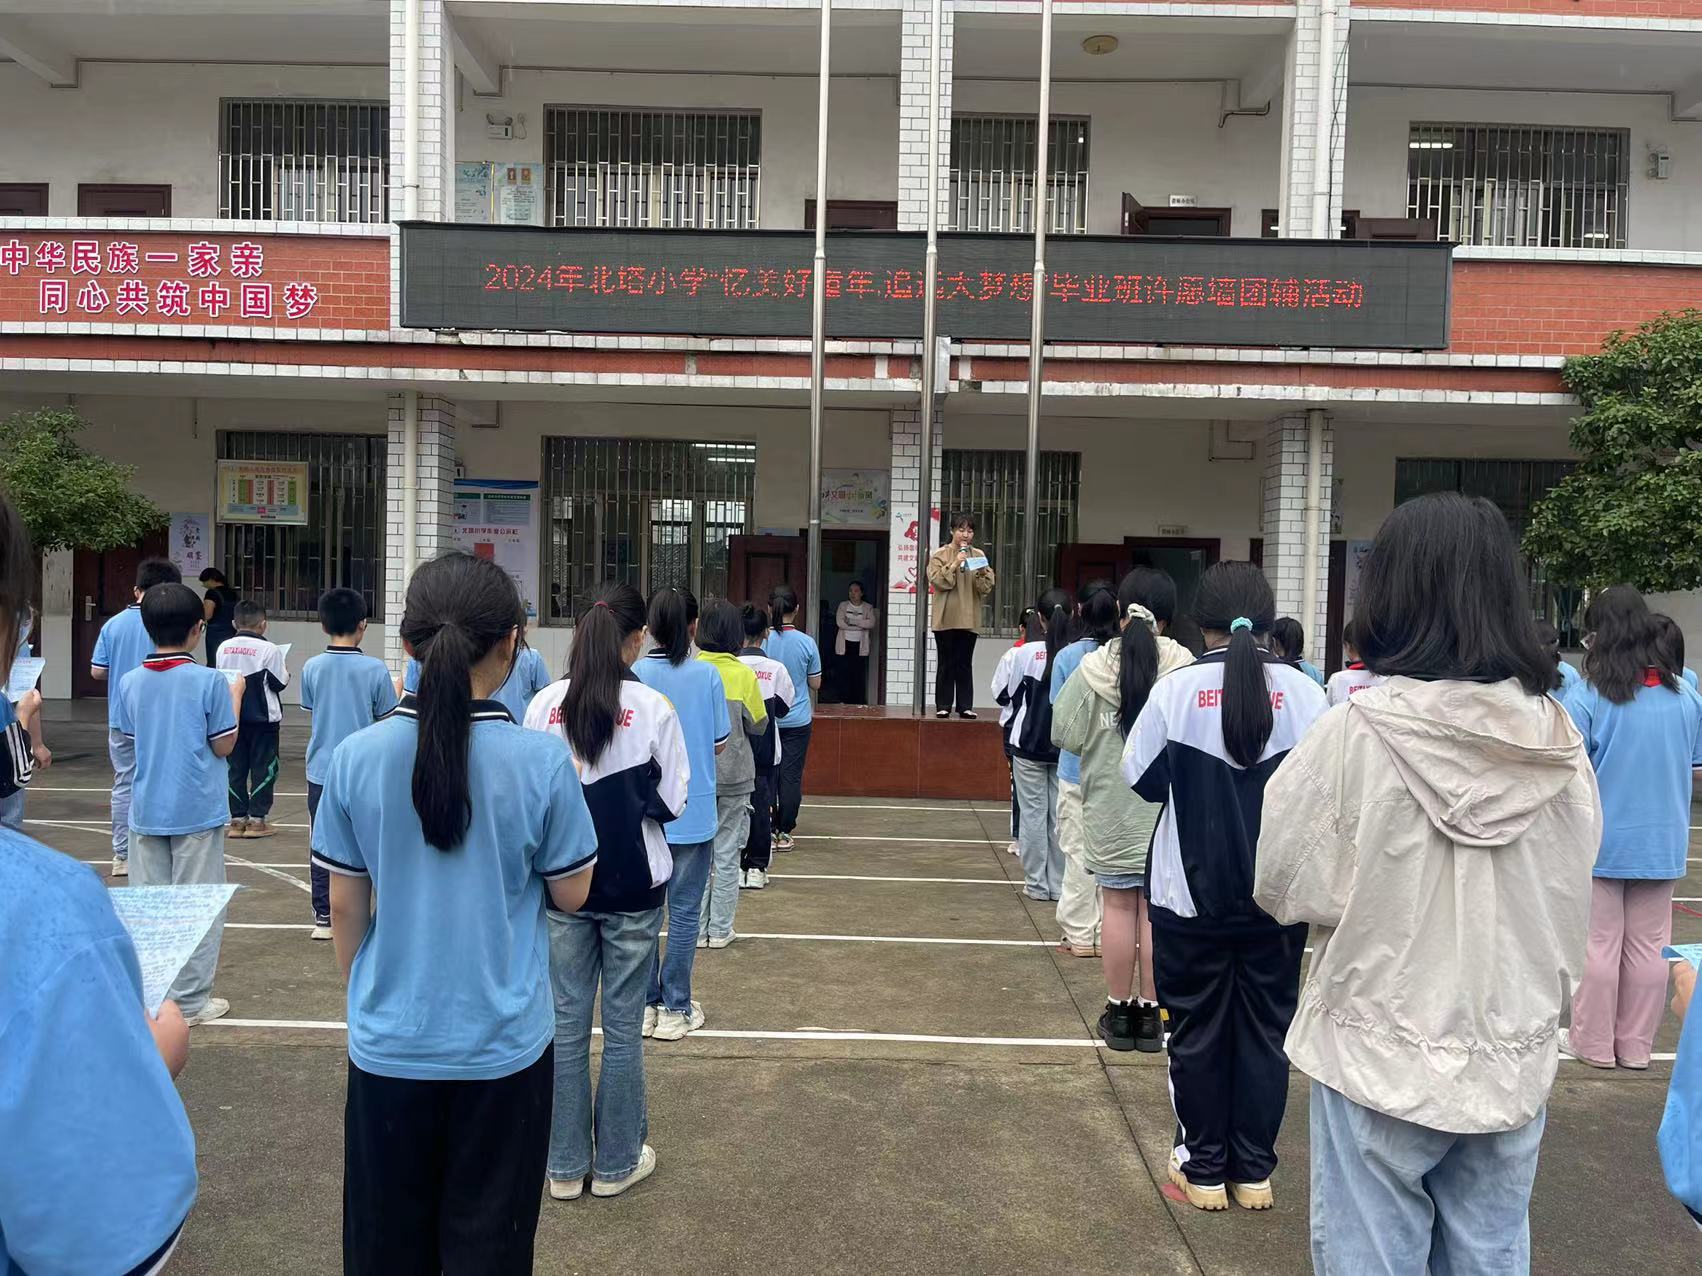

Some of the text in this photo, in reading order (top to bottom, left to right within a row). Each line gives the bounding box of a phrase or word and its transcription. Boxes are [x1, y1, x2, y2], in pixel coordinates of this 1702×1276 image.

[0, 240, 264, 277] 中华民族一家亲
[40, 279, 318, 319] 同心共筑中国梦
